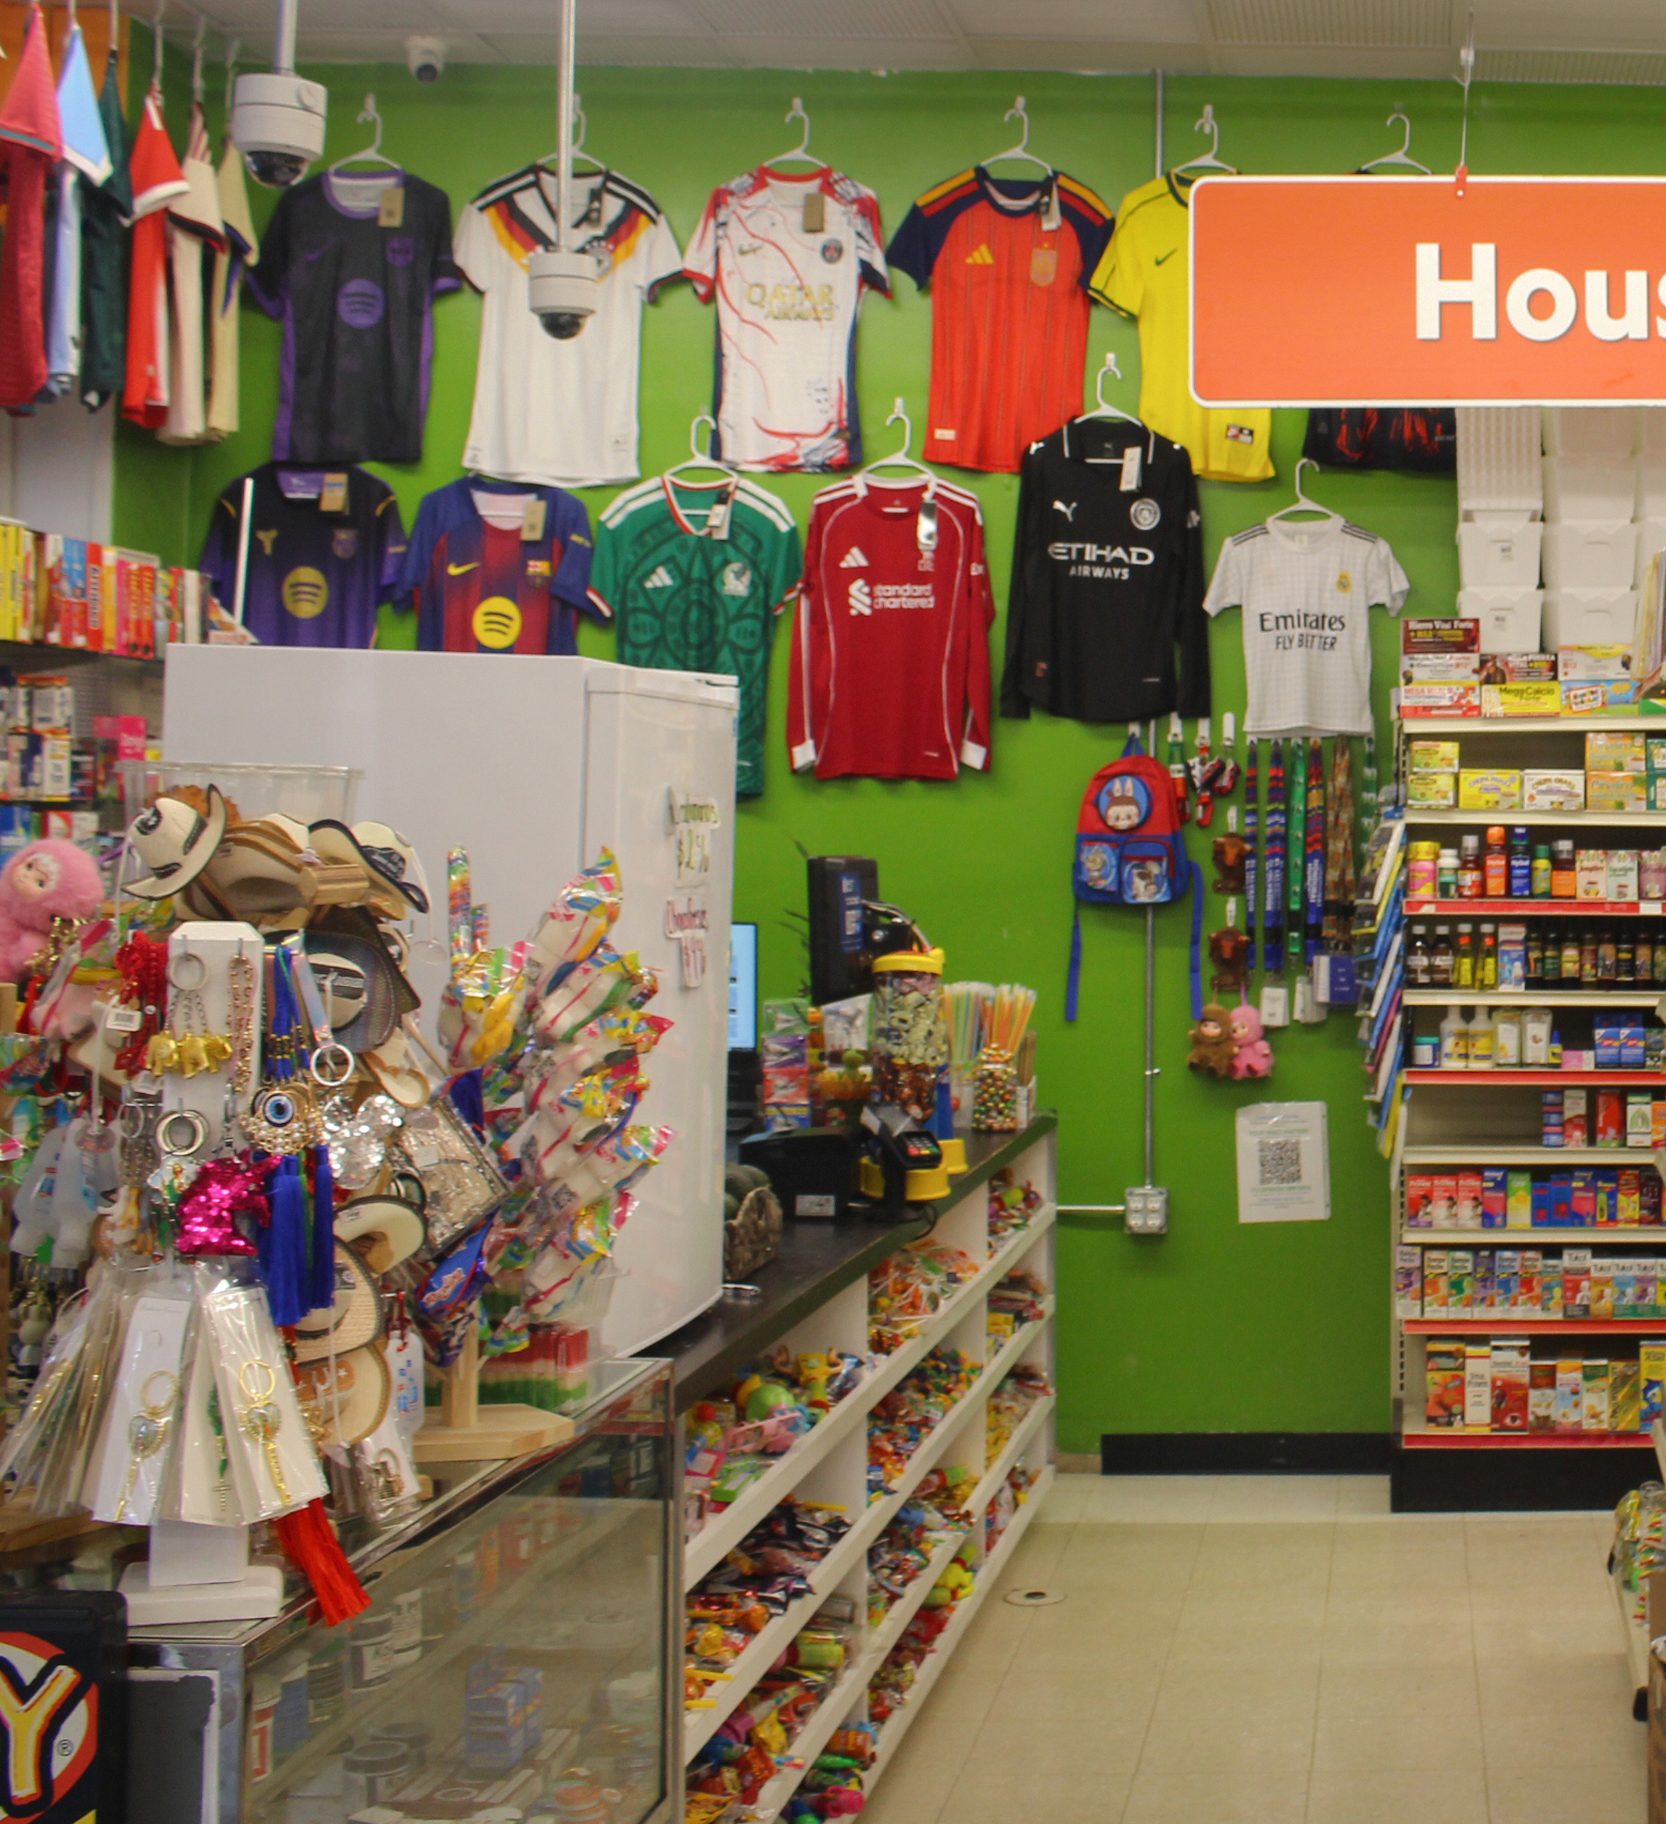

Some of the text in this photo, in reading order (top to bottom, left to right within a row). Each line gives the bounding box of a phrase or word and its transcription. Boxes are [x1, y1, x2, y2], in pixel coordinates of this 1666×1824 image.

[746, 284, 834, 308] QATAR
[1047, 542, 1155, 566] ETIHAD
[1069, 566, 1130, 581] AIRWAYS
[872, 582, 932, 596] standard
[872, 596, 934, 608] chartered
[1259, 609, 1347, 632] Emirates
[1276, 633, 1338, 650] FLY BETTER
